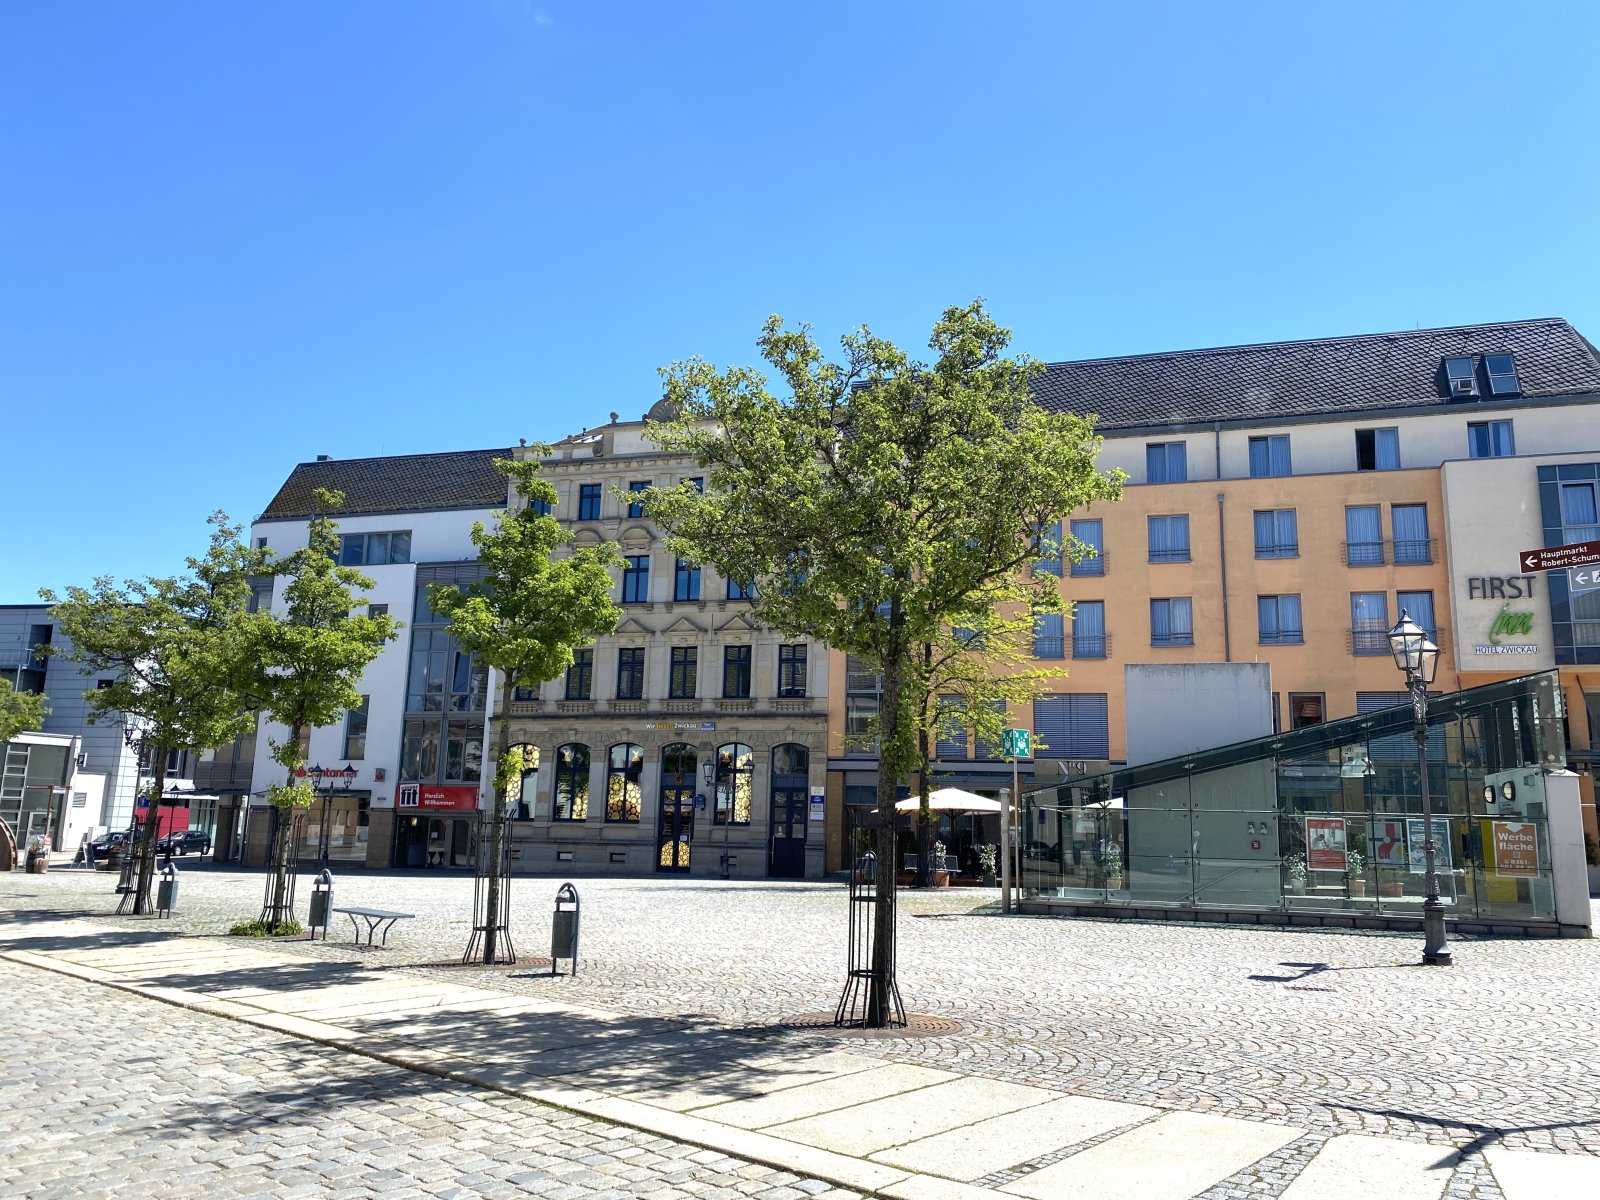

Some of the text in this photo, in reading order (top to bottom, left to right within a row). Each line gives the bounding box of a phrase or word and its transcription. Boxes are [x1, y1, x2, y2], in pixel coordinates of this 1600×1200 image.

[1540, 546, 1588, 559] Hauptmarkt
[1541, 554, 1600, 567] Robert-Schum
[1468, 575, 1536, 600] FIRST
[1475, 645, 1538, 654] HOTEL ZWICKAU
[308, 767, 359, 777] Sntaner
[401, 789, 418, 805] fit
[1498, 832, 1533, 841] Werbe
